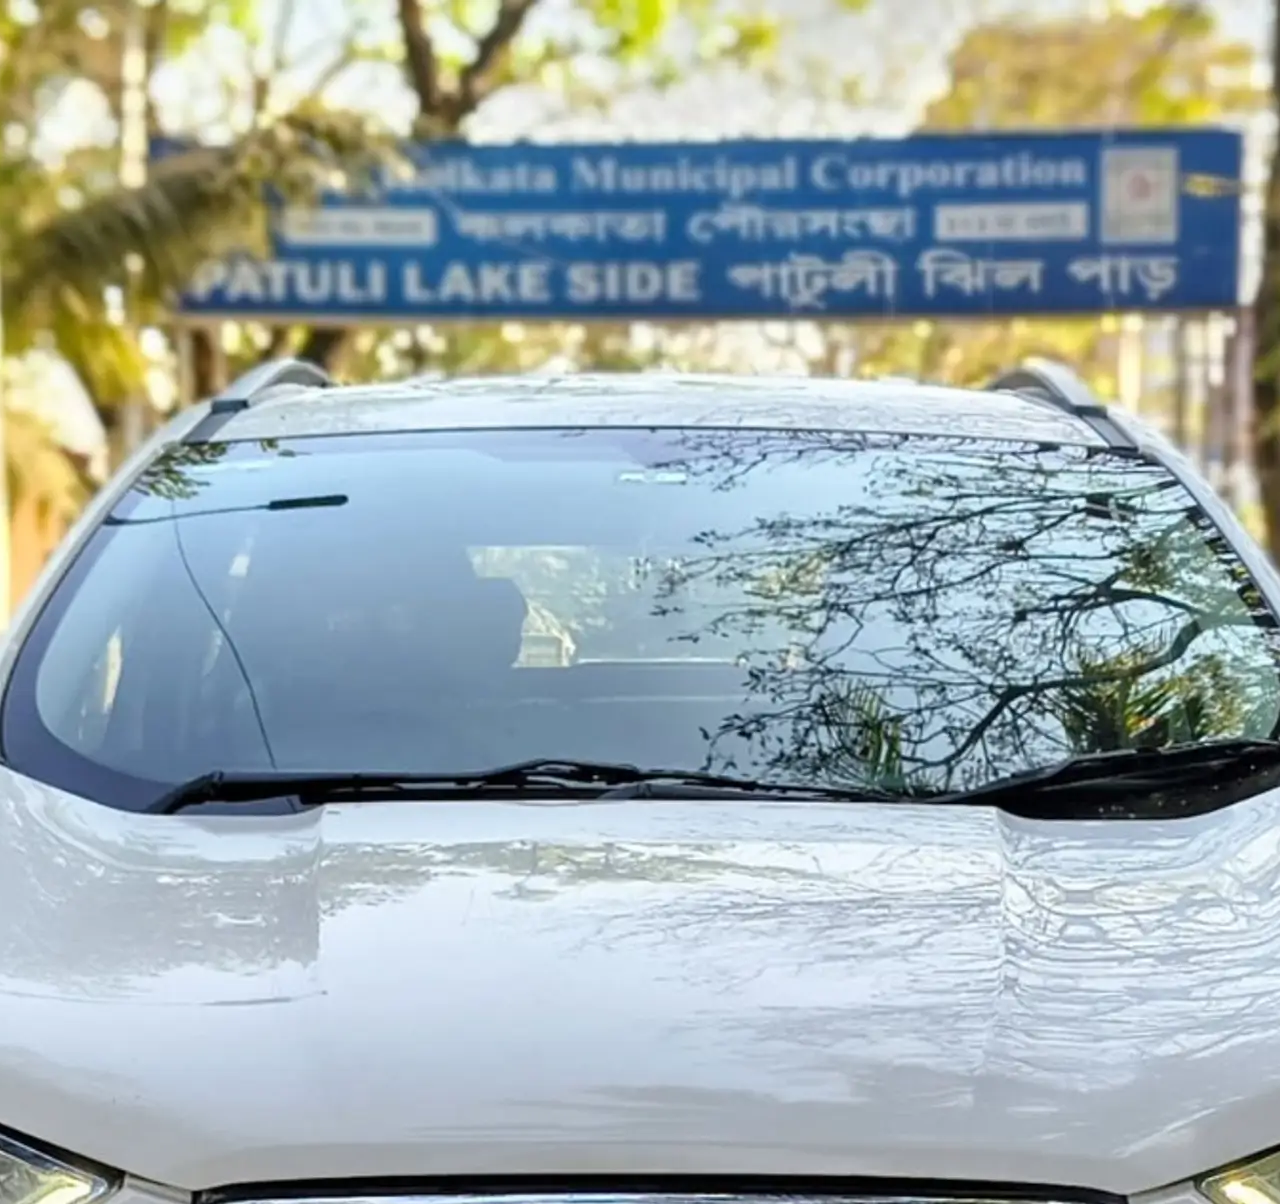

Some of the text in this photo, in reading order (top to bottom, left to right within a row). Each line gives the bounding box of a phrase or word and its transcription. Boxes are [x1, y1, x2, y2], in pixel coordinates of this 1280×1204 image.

[572, 152, 798, 199] Municipal
[810, 148, 1086, 199] Corporation
[191, 257, 703, 305] PATULI LAKE SIDE
[726, 246, 1180, 310] পাটুলী ঝিল পাড়
